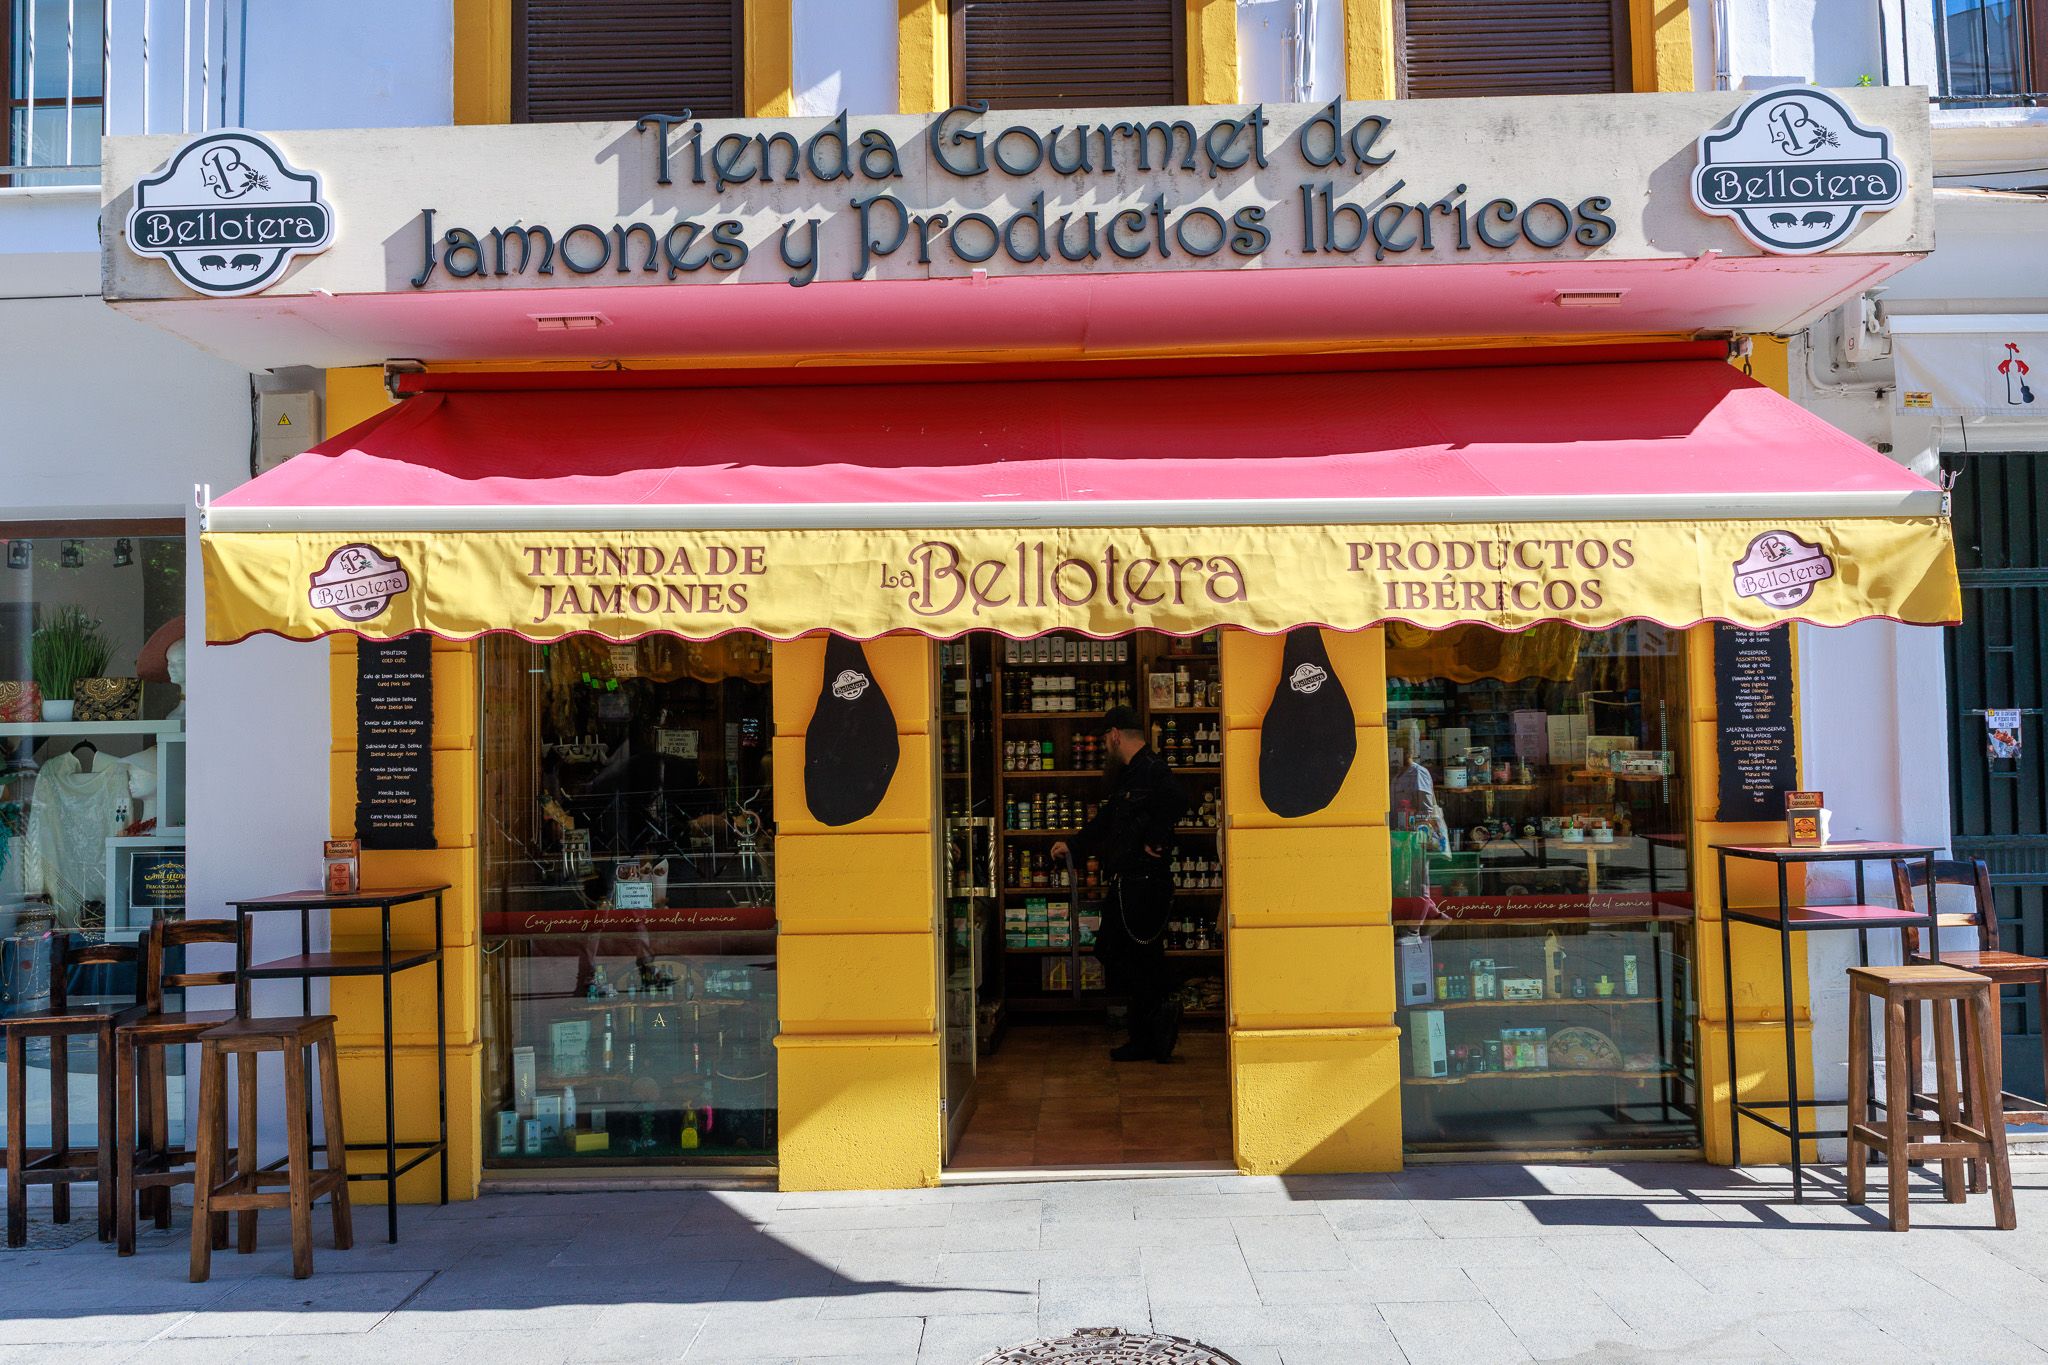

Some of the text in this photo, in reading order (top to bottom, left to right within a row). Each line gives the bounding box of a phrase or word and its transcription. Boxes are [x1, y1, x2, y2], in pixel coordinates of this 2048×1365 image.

[636, 94, 1396, 193] Tienda Gourmet de
[1714, 168, 1888, 202] Bellotera
[146, 211, 316, 245] Bellotera
[411, 180, 1617, 288] Jamones y Productos Ibéricos
[523, 545, 767, 577] TIENDA DE
[1346, 538, 1635, 573] PRODUCTOS
[318, 577, 403, 605] Bellotera
[880, 541, 1248, 616] La Bellotera
[1383, 573, 1604, 611] IBÉRICOS
[1742, 563, 1827, 593] Bellotera
[533, 583, 748, 624] JAMONES
[525, 914, 546, 929] Con
[545, 915, 581, 933] jamón
[582, 919, 592, 930] y
[594, 912, 618, 924] buen
[620, 916, 642, 924] vino
[659, 912, 685, 924] anda
[688, 912, 697, 923] el
[699, 915, 736, 923] camino
[1436, 900, 1458, 914] Con
[1457, 901, 1493, 919] jamón
[1494, 906, 1504, 918] y
[1507, 899, 1531, 911] buen
[1534, 901, 1556, 910] vino
[1573, 897, 1600, 910] anda
[1600, 898, 1612, 909] el
[1615, 900, 1652, 908] camino
